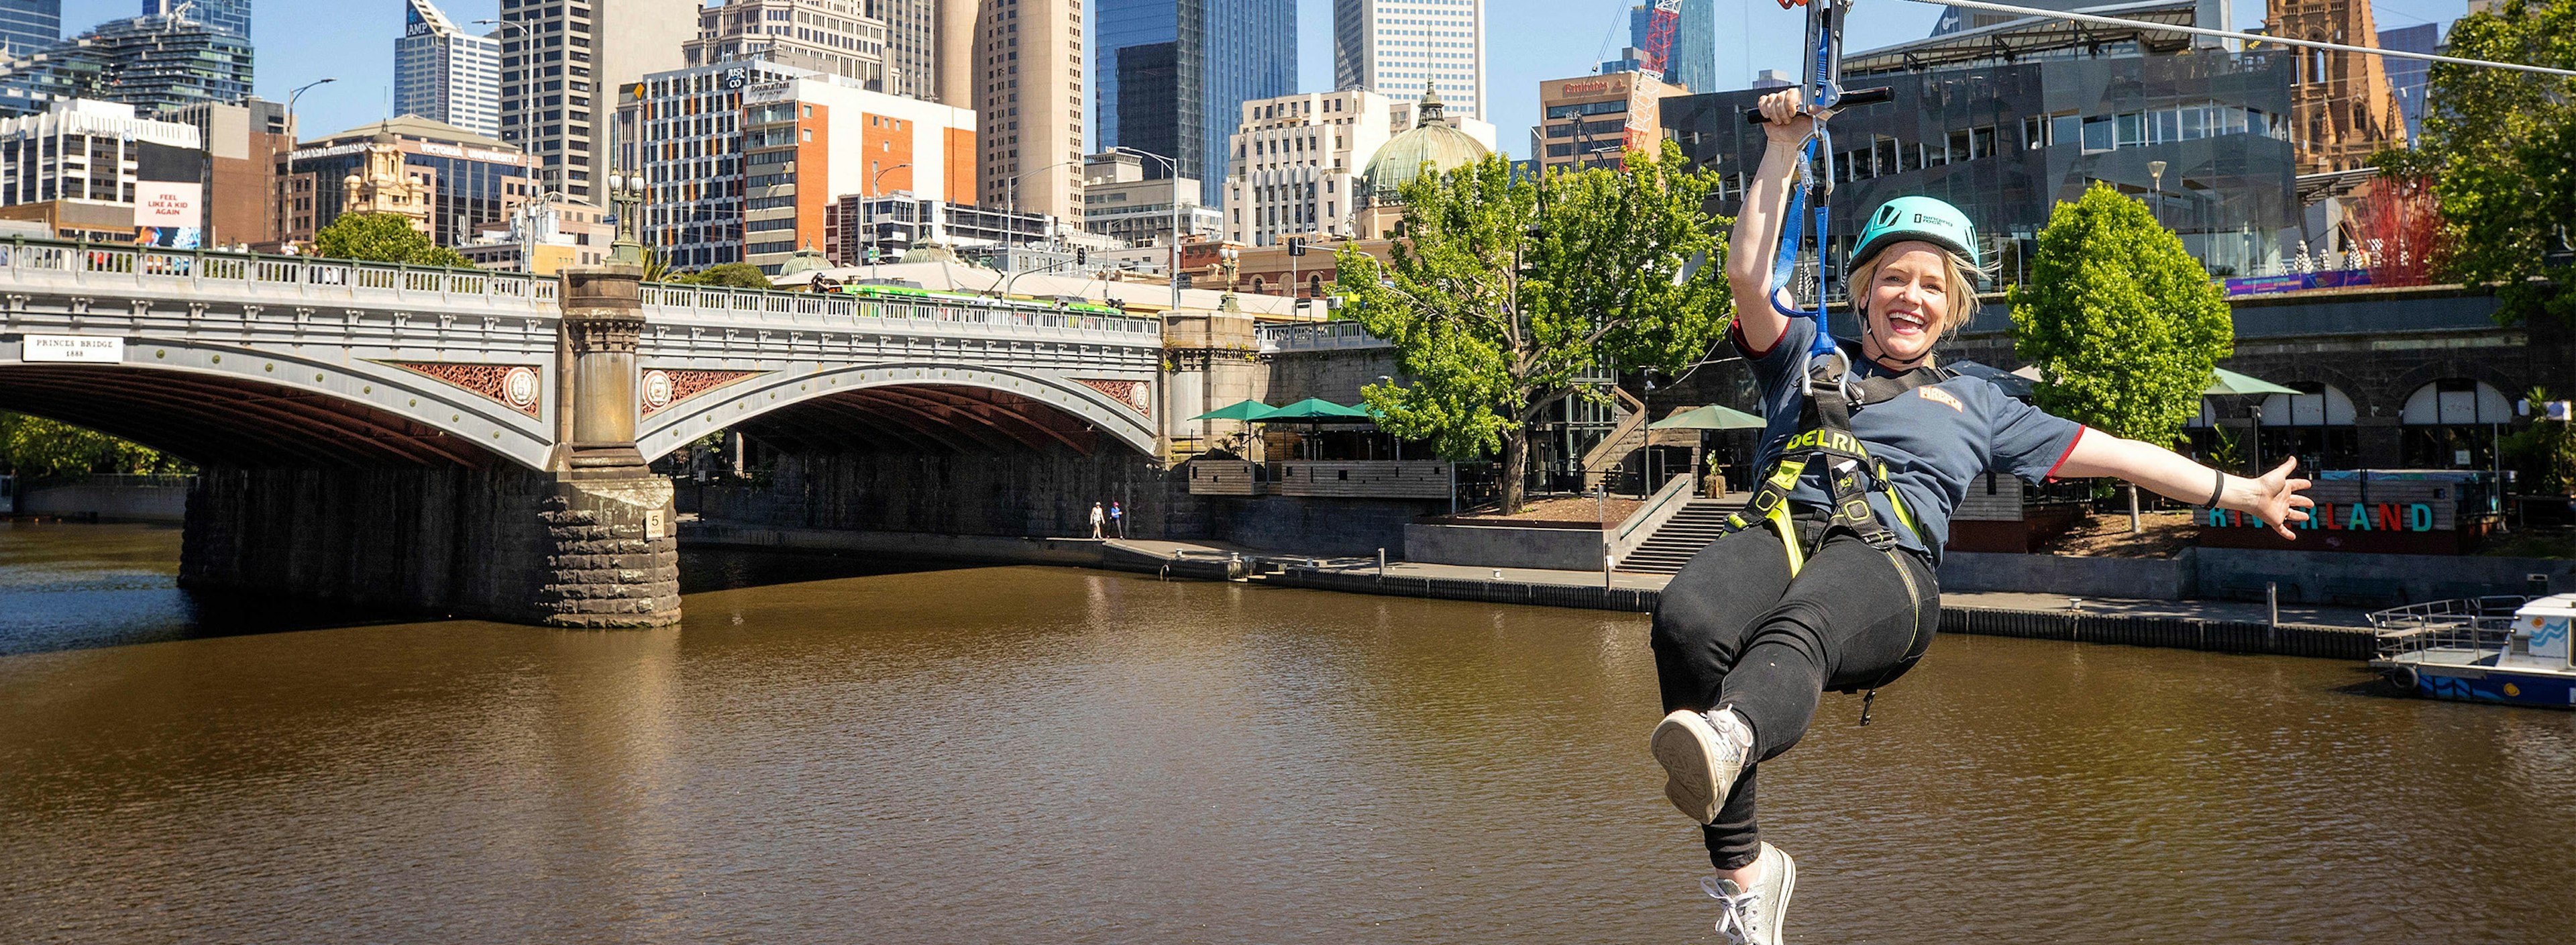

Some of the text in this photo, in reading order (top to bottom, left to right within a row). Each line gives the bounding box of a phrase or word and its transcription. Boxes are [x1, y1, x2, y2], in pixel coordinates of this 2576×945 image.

[408, 22, 427, 36] AMP
[1564, 81, 1609, 94] Emirates
[420, 143, 519, 164] VICTORIA UNIVERSITY
[36, 339, 74, 347] PRINCES
[652, 515, 659, 526] 5
